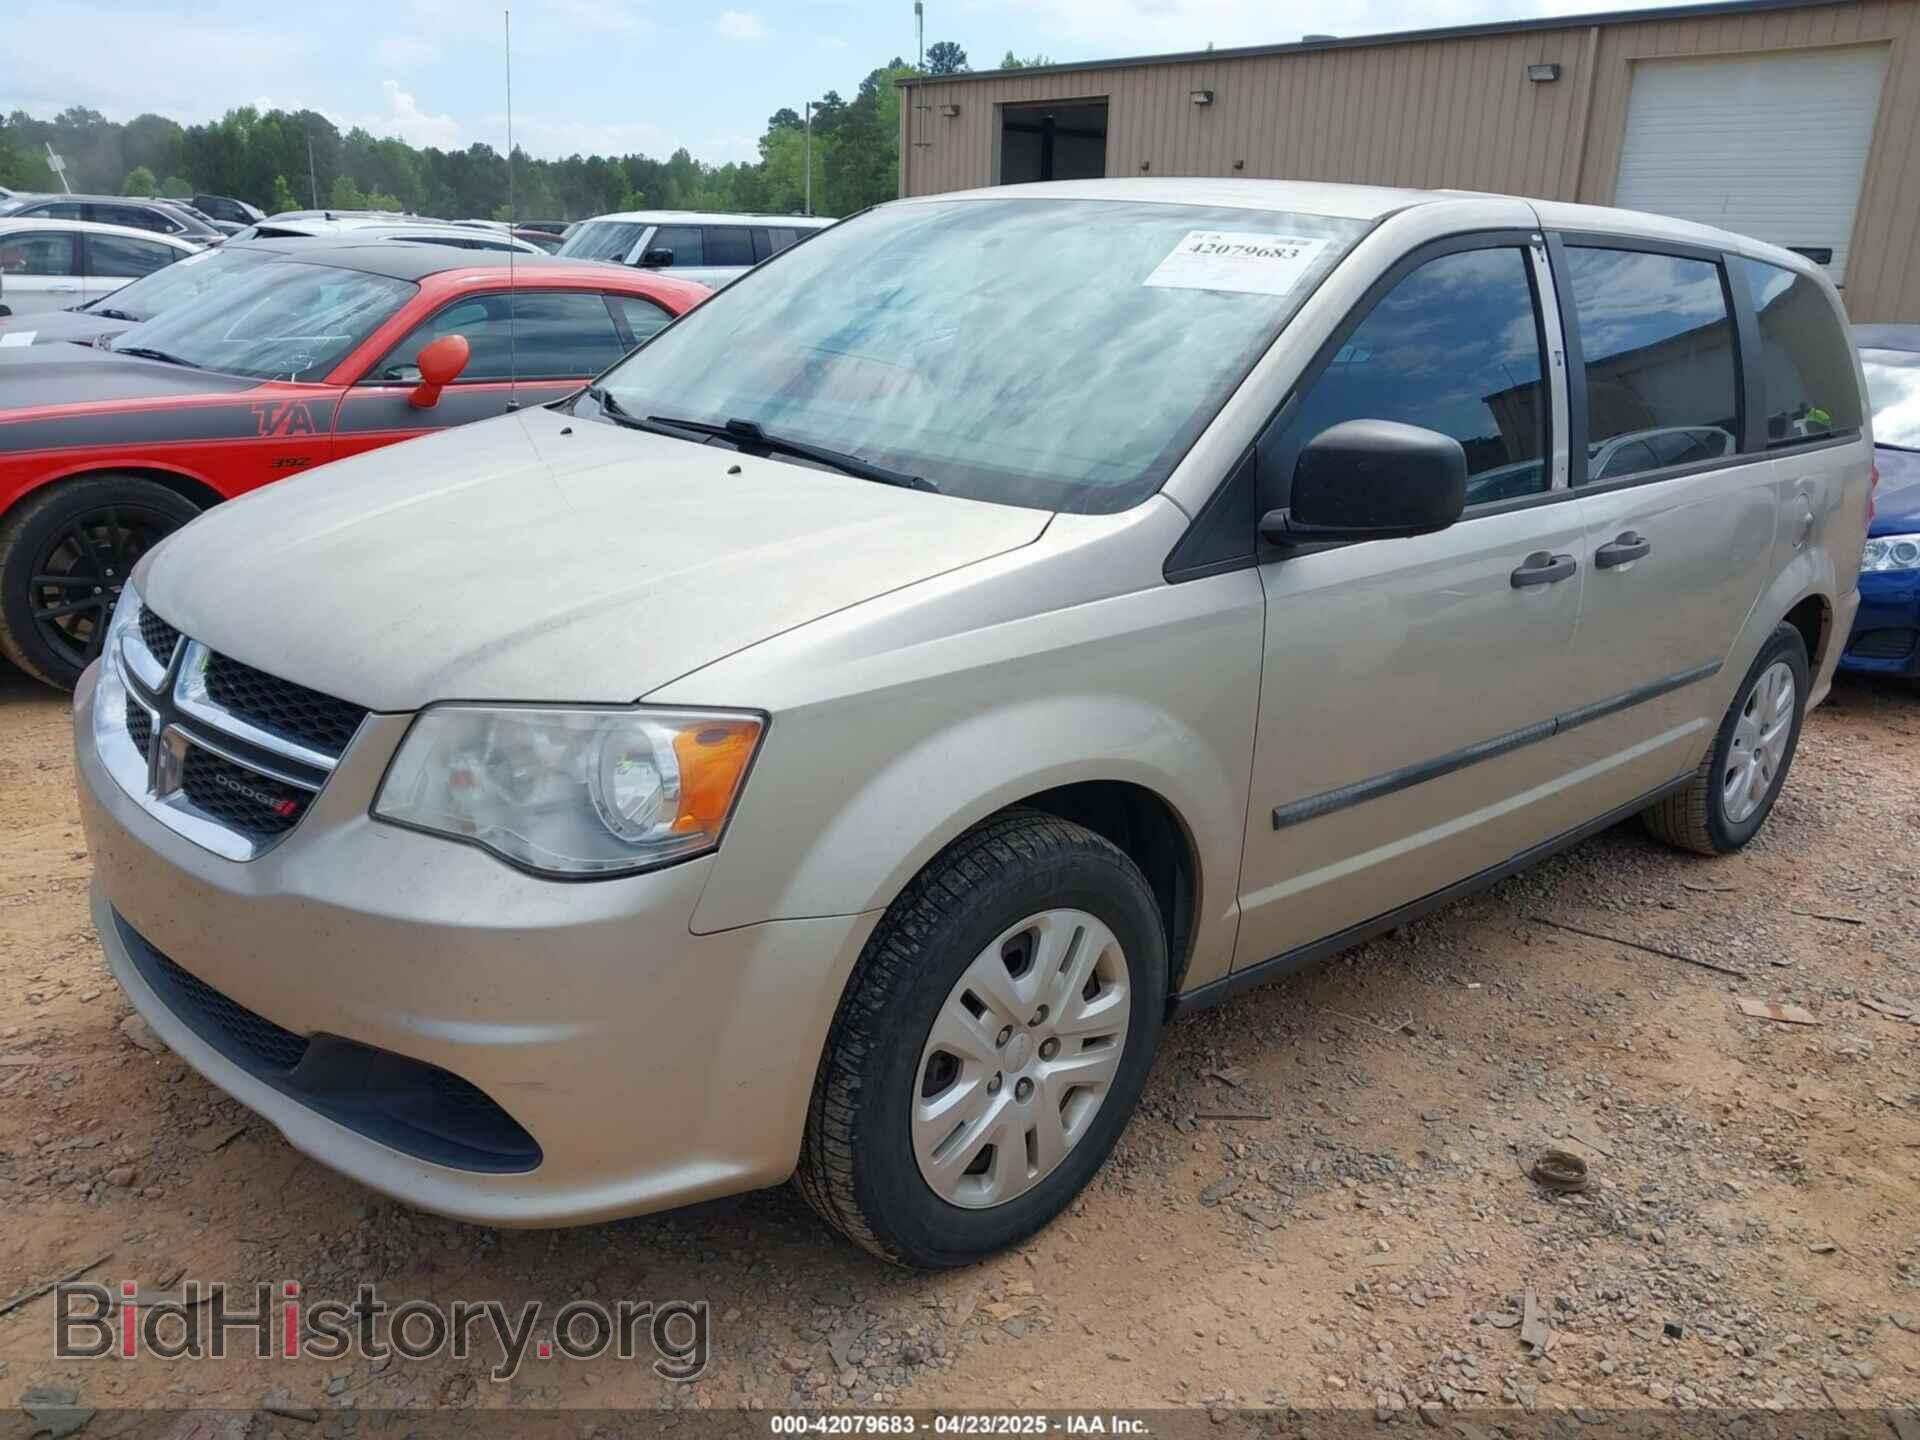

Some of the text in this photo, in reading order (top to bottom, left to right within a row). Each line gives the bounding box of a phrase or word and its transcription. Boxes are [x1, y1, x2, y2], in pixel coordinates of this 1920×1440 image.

[1189, 242, 1301, 259] 42079683
[272, 457, 312, 468] 392
[215, 774, 283, 810] DODGE
